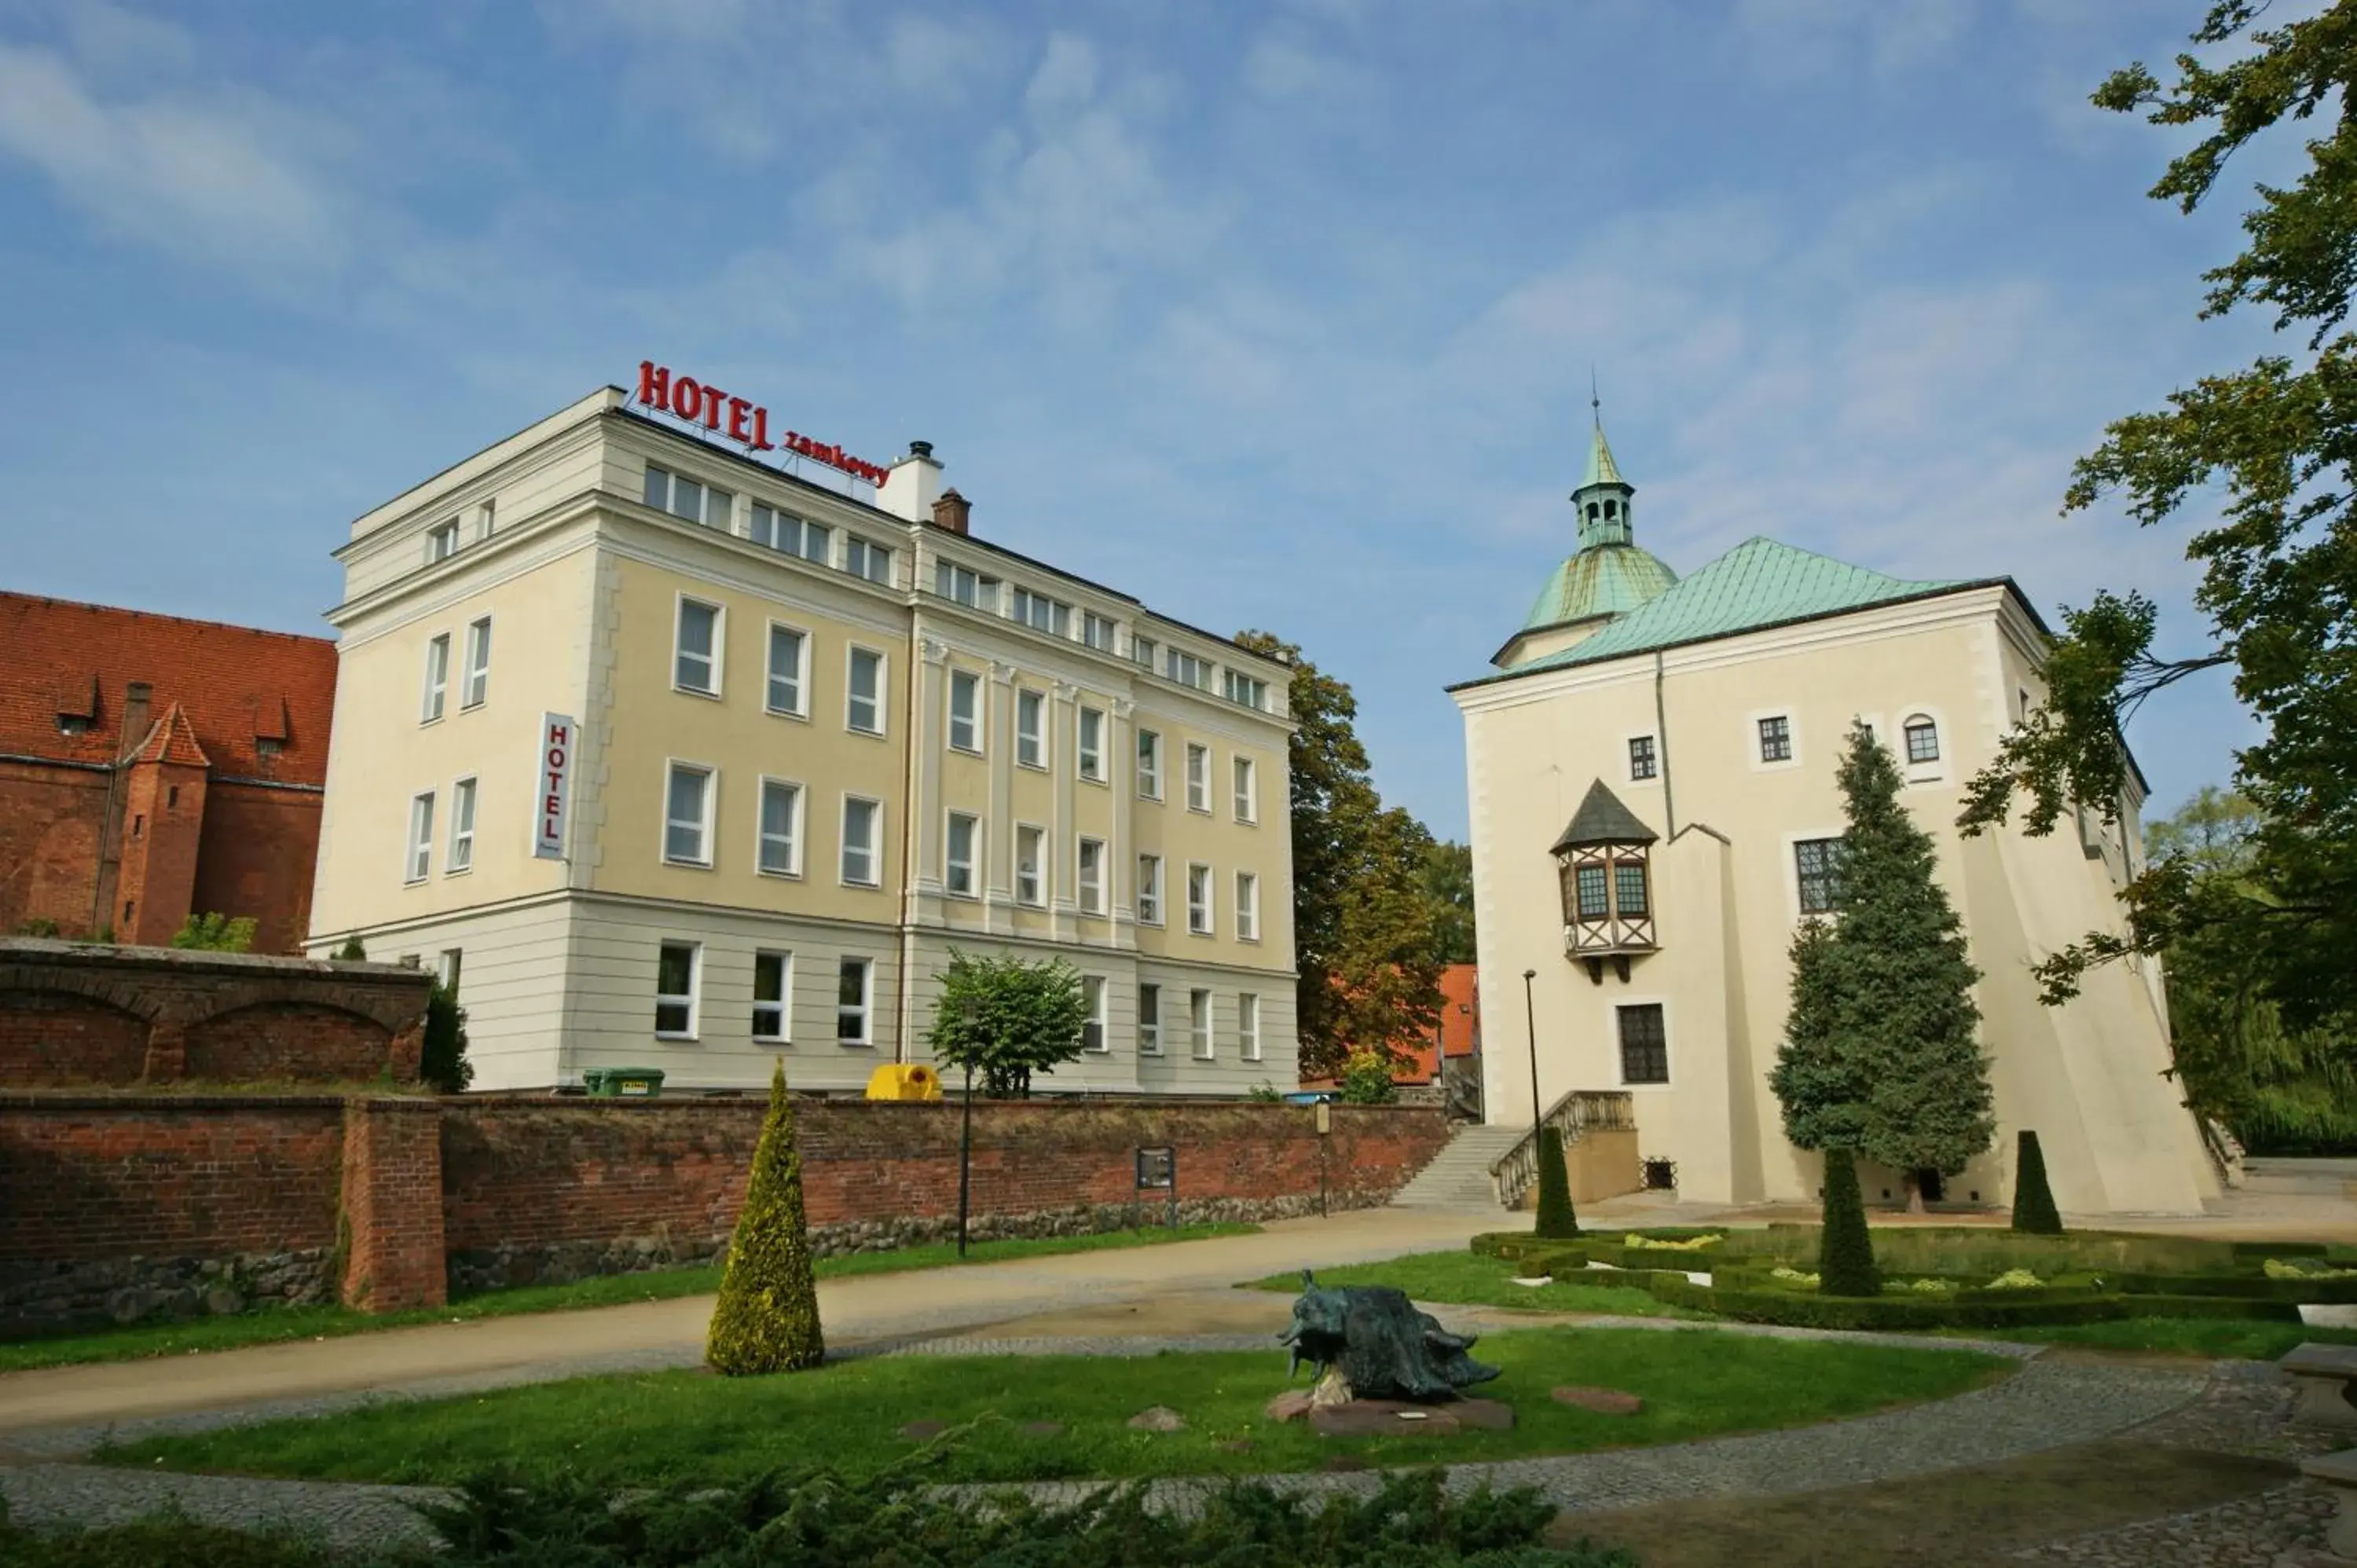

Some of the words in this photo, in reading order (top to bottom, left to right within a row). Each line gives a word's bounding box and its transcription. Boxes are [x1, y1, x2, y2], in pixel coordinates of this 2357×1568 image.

[640, 360, 775, 451] HOTEL
[784, 430, 891, 489] zamkowy
[545, 724, 566, 839] HOTEL
